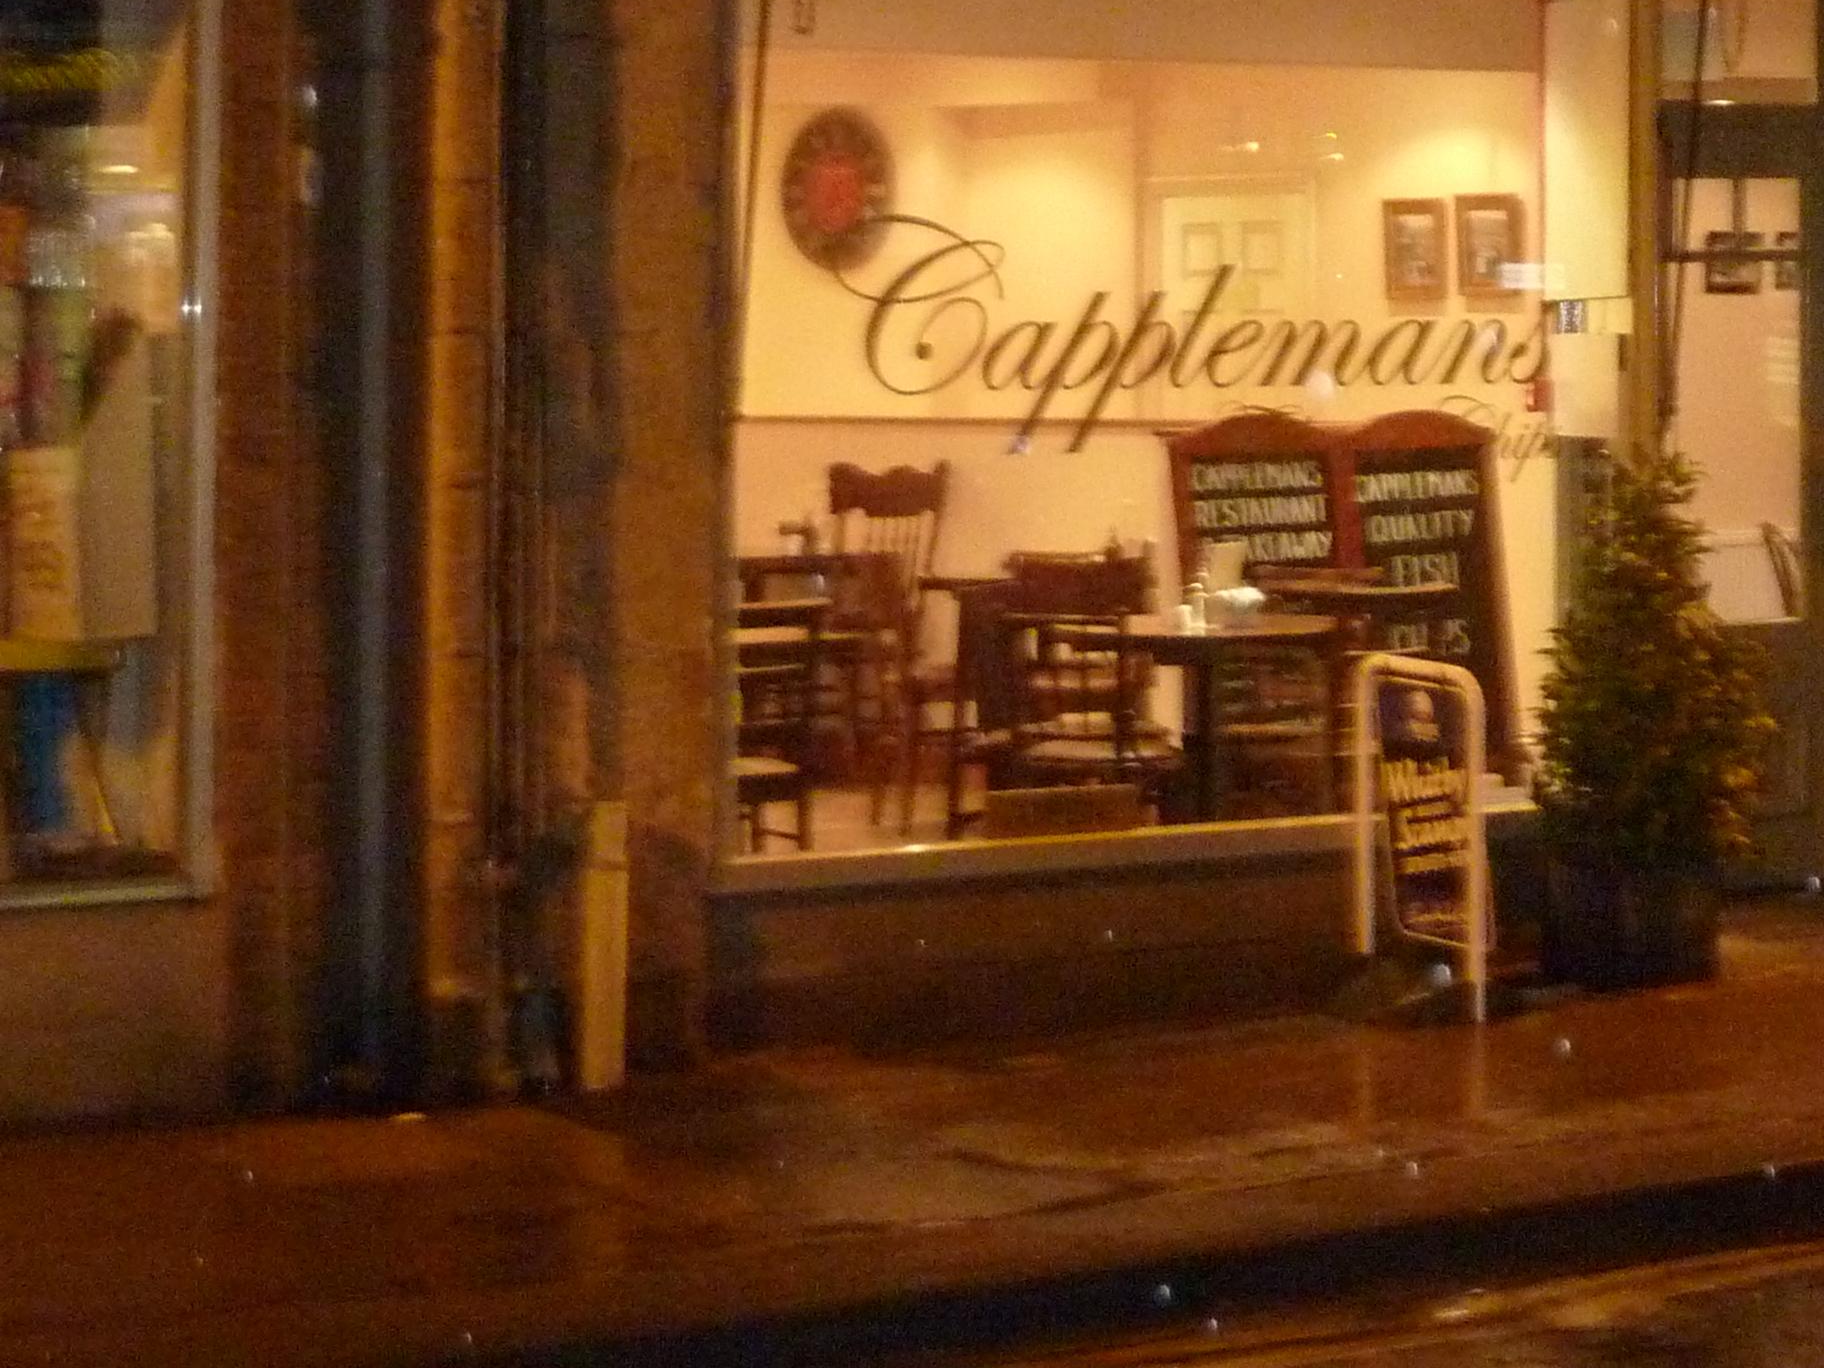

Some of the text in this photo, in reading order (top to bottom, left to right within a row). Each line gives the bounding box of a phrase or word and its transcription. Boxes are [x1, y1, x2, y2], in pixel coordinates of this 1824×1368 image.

[833, 212, 1549, 455] Capplemans
[1193, 494, 1328, 528] RESTAURANT
[1364, 508, 1475, 543] QUALITY
